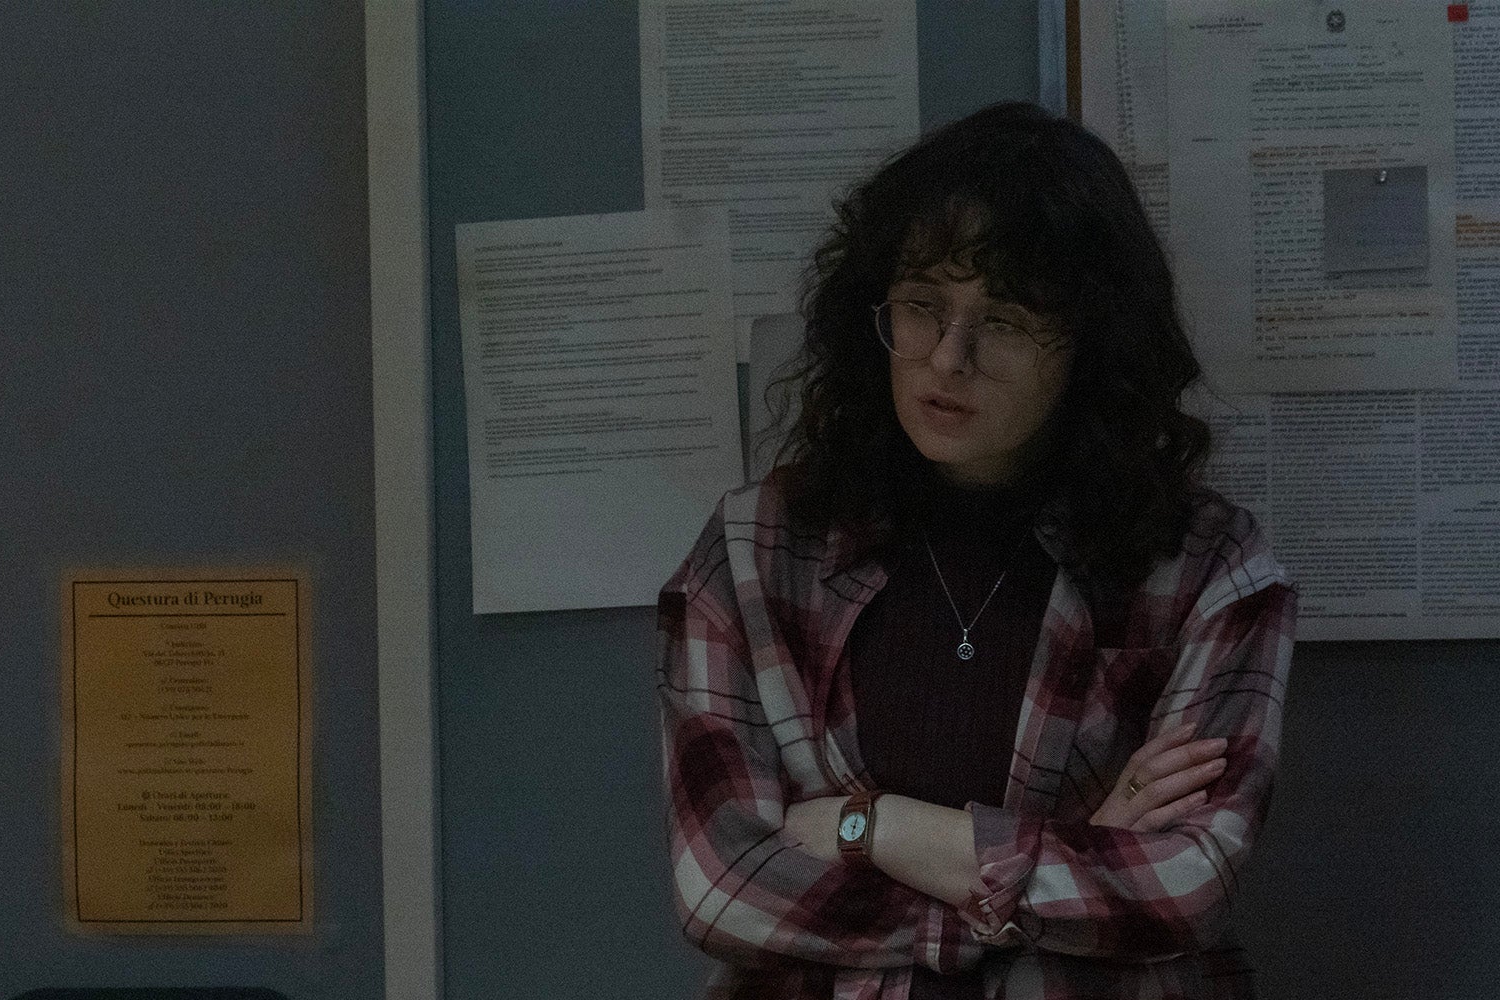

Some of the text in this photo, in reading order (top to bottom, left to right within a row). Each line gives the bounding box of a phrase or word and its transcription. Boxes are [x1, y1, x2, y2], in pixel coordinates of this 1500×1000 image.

[107, 591, 263, 609] Questura di Perugia
